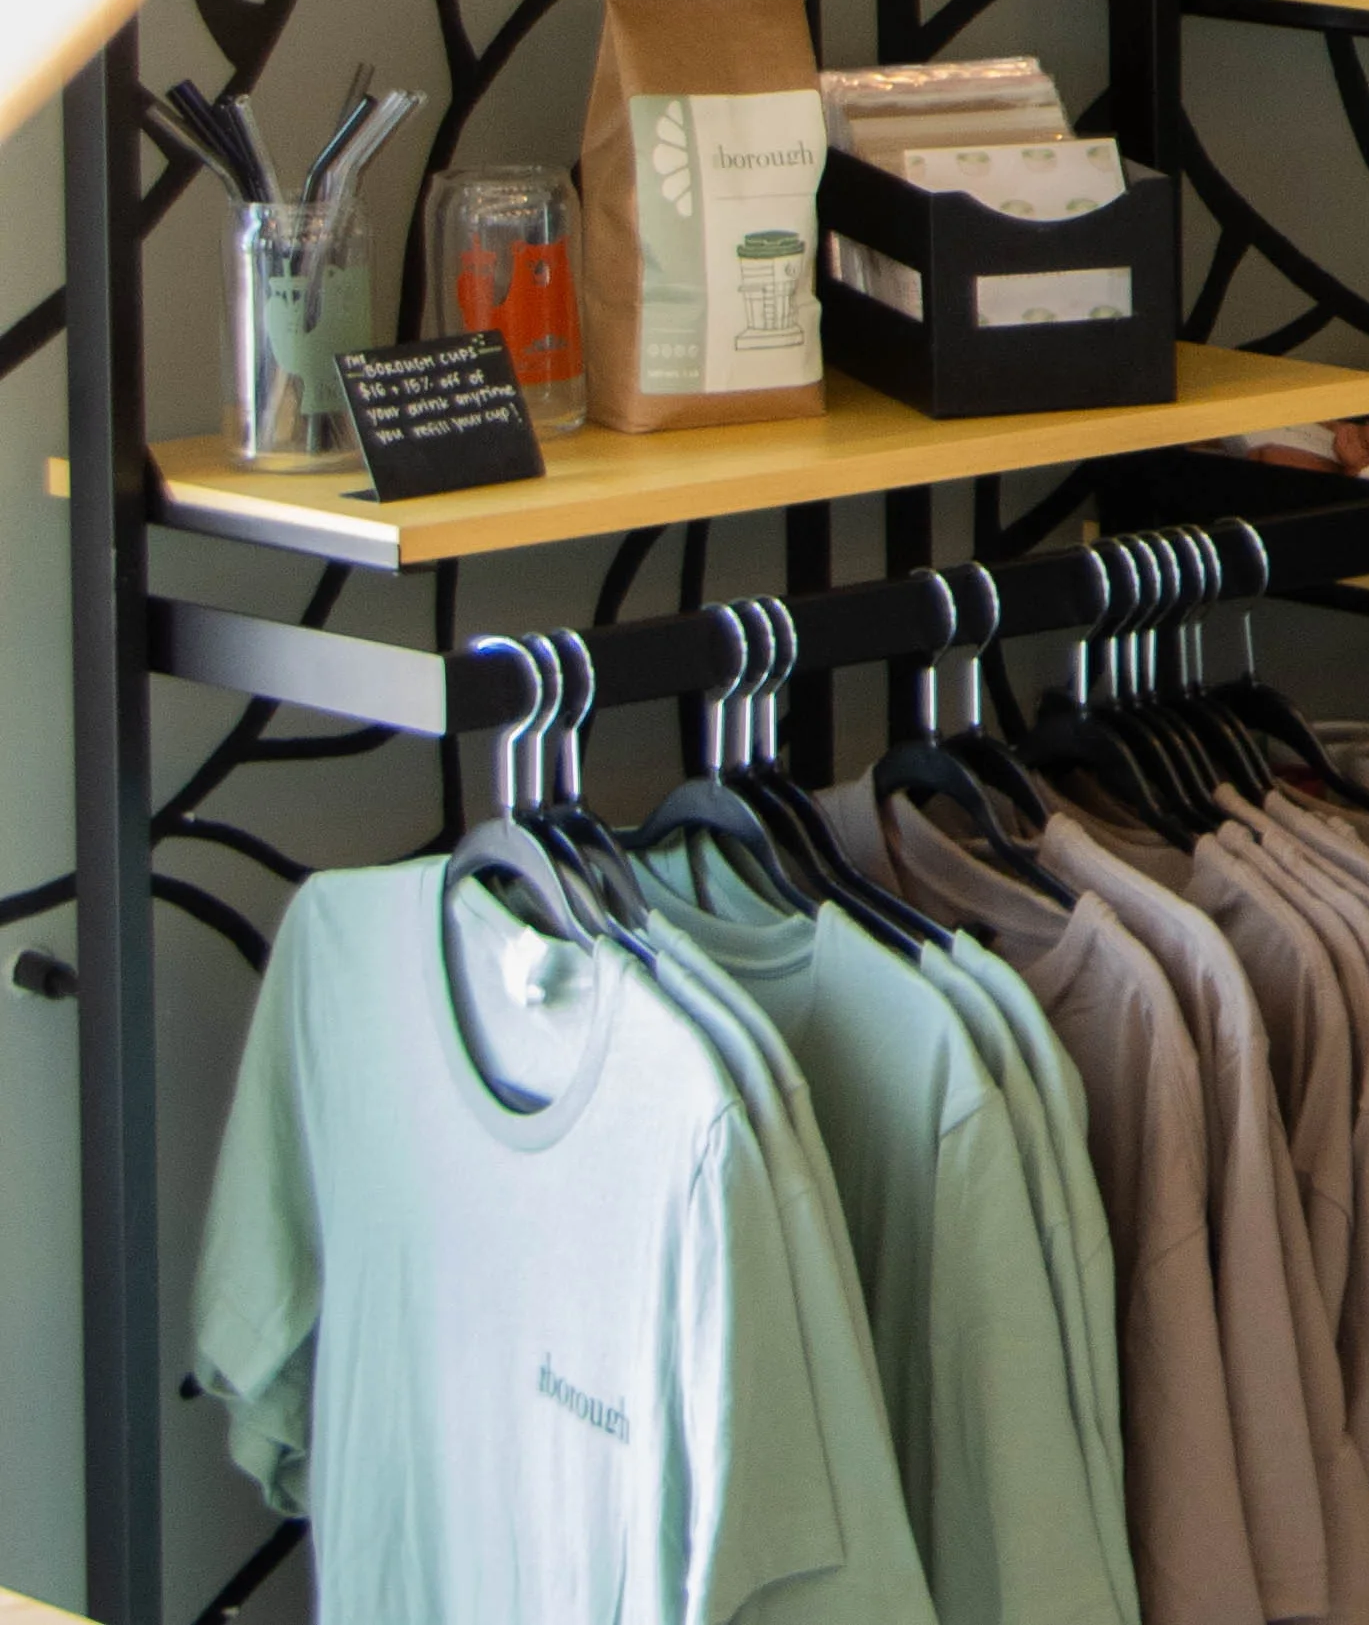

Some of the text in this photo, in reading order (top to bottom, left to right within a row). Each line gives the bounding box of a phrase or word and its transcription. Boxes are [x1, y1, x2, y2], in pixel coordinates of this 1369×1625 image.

[718, 140, 814, 169] borough
[363, 355, 436, 379] BOROUGH
[439, 345, 479, 366] CUPS
[366, 406, 401, 427] your
[455, 383, 517, 408] anytime
